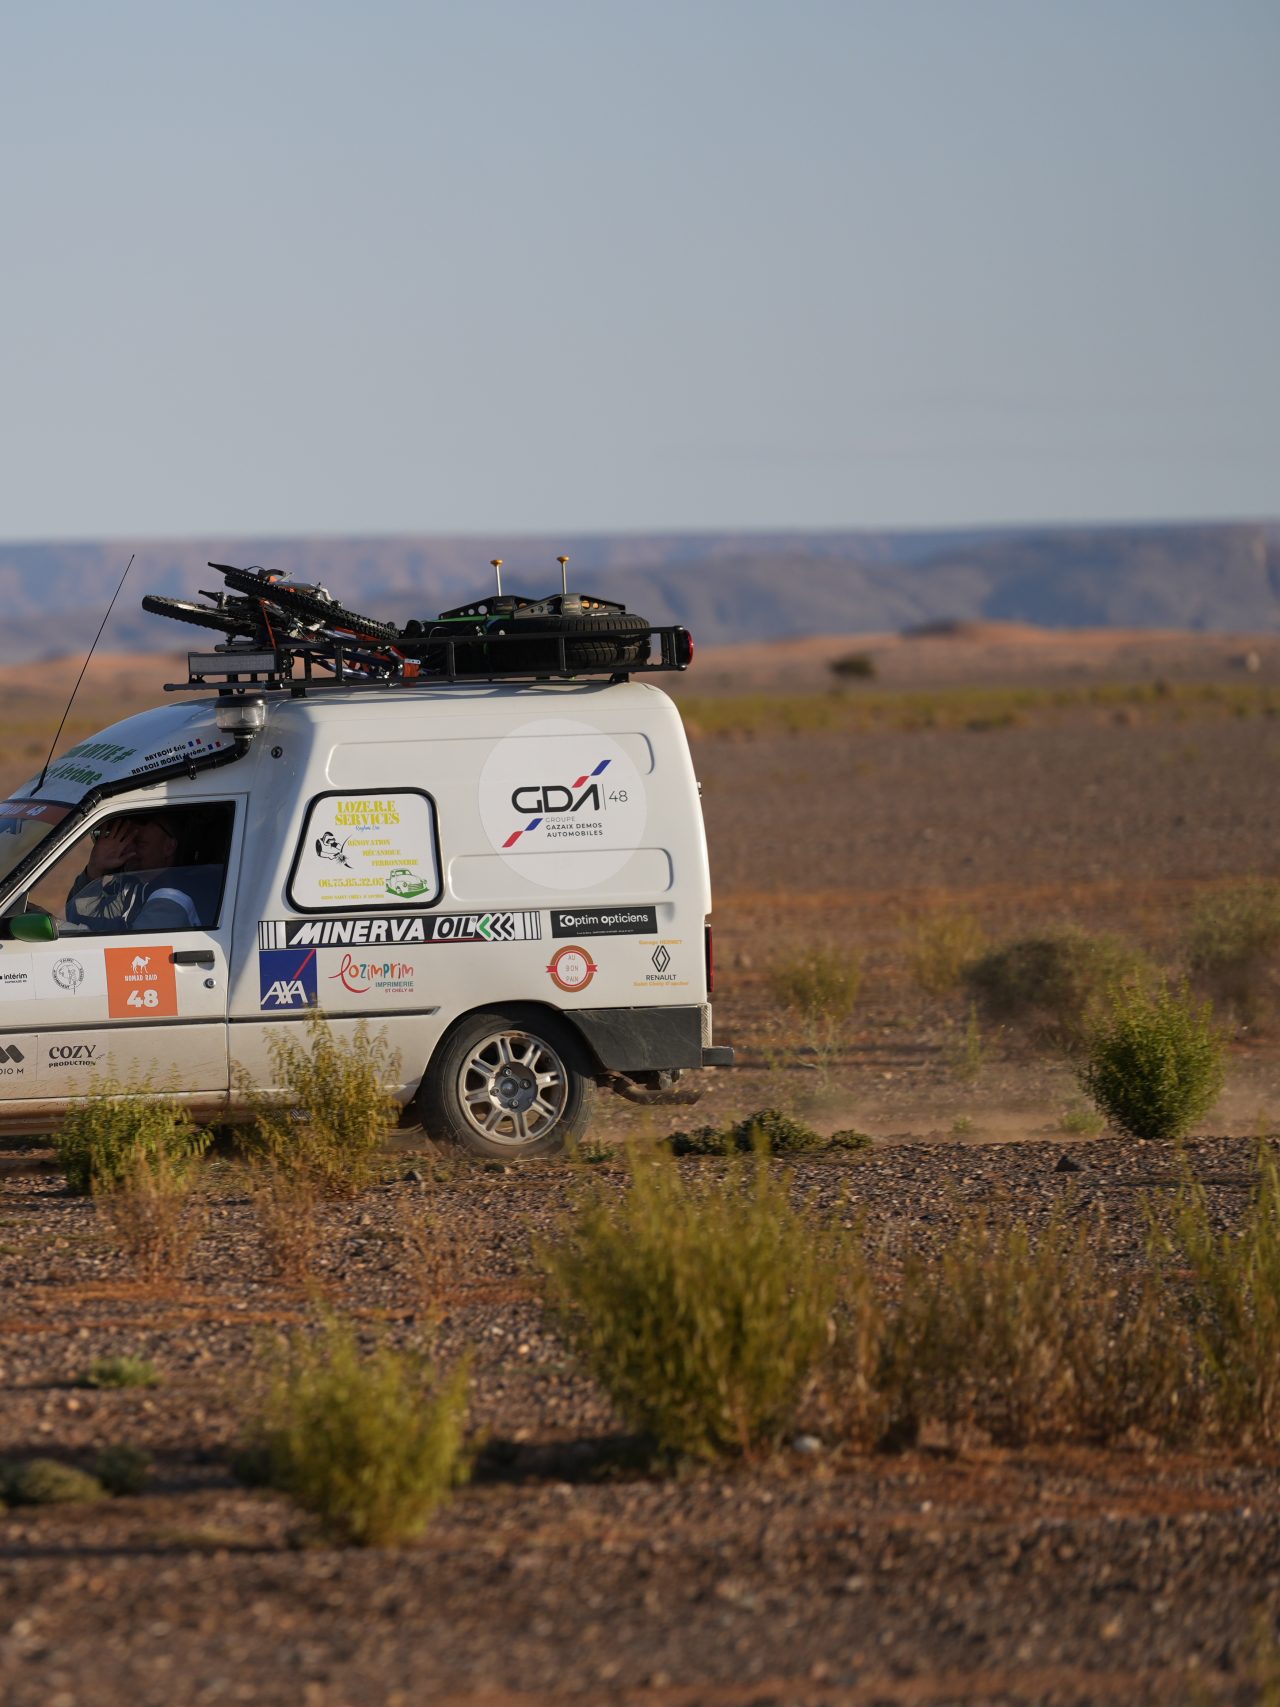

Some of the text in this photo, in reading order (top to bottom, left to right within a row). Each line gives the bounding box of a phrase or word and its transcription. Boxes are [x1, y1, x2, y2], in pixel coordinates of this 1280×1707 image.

[144, 748, 173, 761] RAYBOIS
[131, 761, 160, 775] RAYBOIS
[511, 783, 629, 814] GDA 48
[335, 812, 401, 826] SERVICES
[547, 829, 604, 838] AUTOMOBILES
[601, 913, 649, 926] opticiens
[288, 918, 426, 945] MINERVA
[126, 989, 159, 1008] 48
[260, 980, 308, 1005] AXA
[48, 1045, 97, 1060] COZY
[17, 1067, 24, 1075] M
[48, 1060, 97, 1068] PRODUCTION
